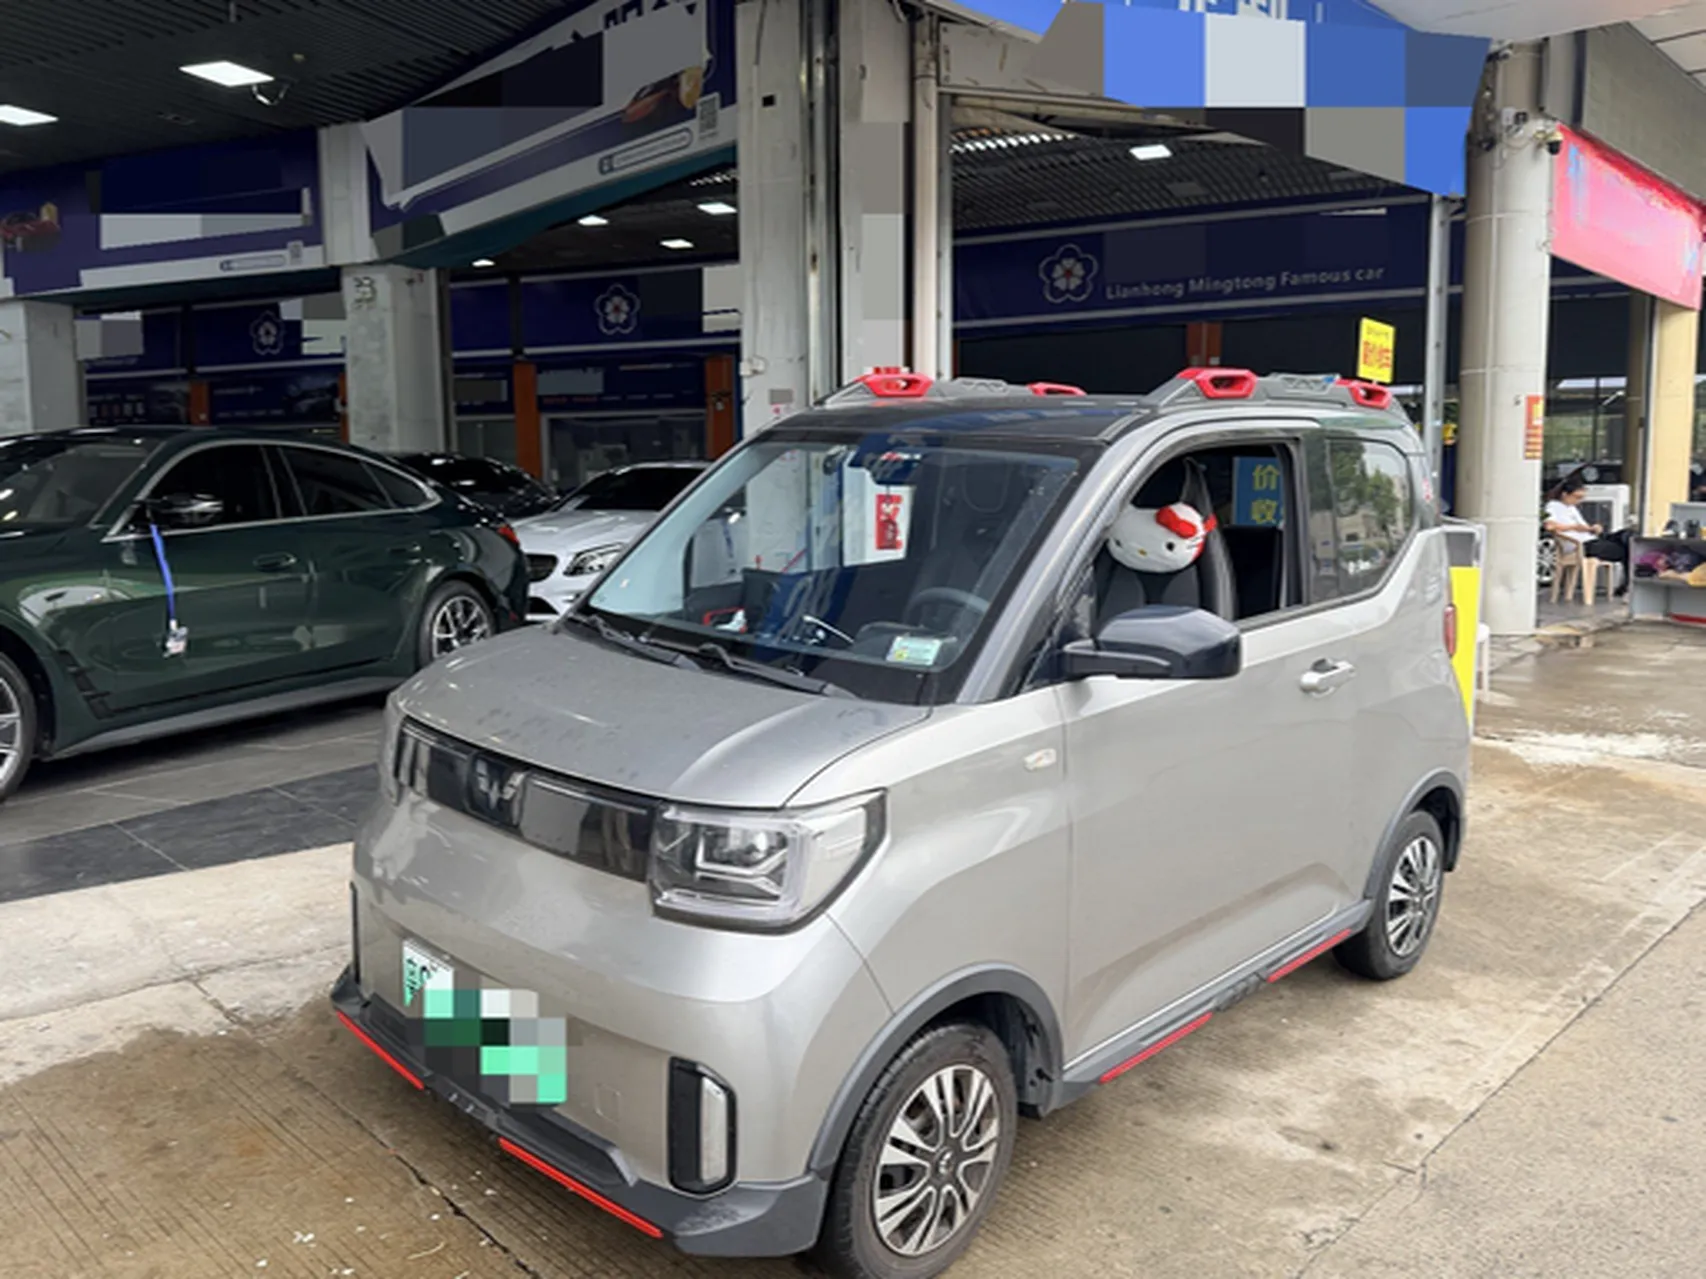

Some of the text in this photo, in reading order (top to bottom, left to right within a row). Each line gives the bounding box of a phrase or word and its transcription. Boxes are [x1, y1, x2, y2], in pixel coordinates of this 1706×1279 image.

[1189, 276, 1276, 295] Mingtong
[1281, 269, 1351, 286] Famous
[1355, 267, 1385, 281] car
